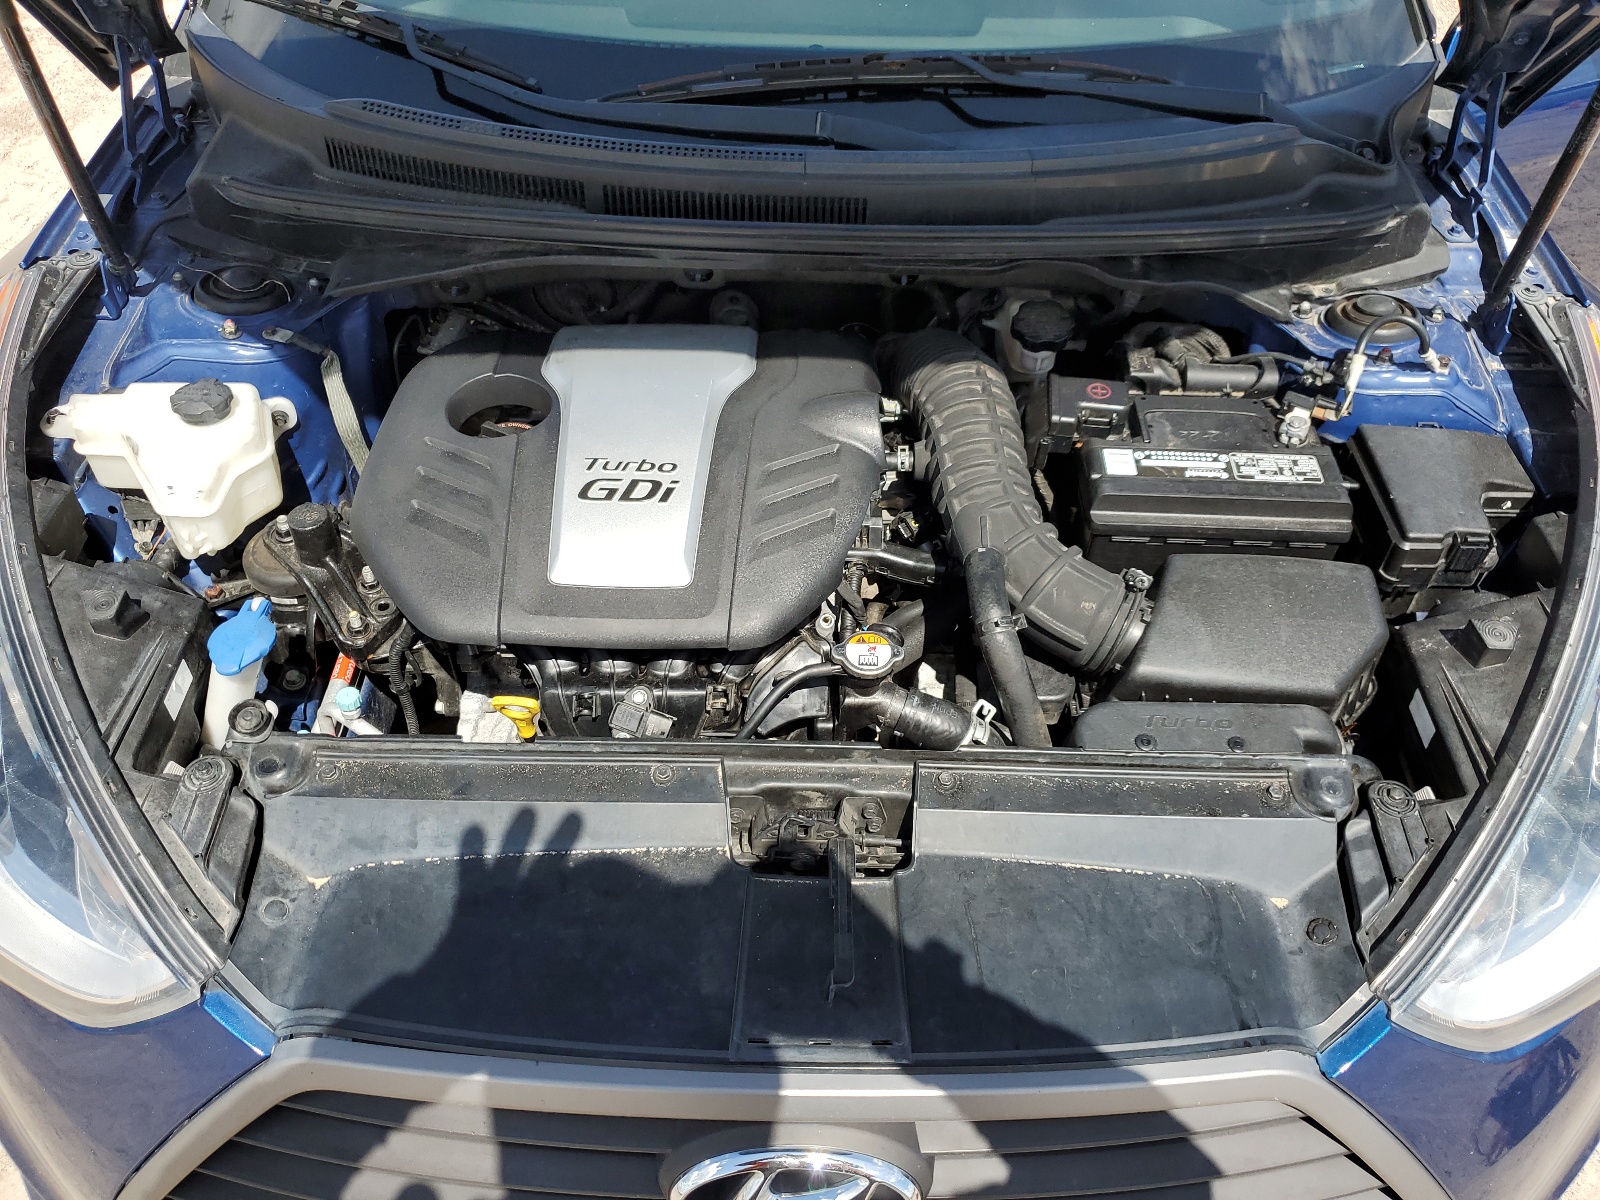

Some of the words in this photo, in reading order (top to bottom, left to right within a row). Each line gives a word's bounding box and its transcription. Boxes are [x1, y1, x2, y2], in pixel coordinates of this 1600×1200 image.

[584, 457, 678, 473] Turbo
[577, 478, 680, 503] GDi
[1142, 714, 1234, 730] Turbo
